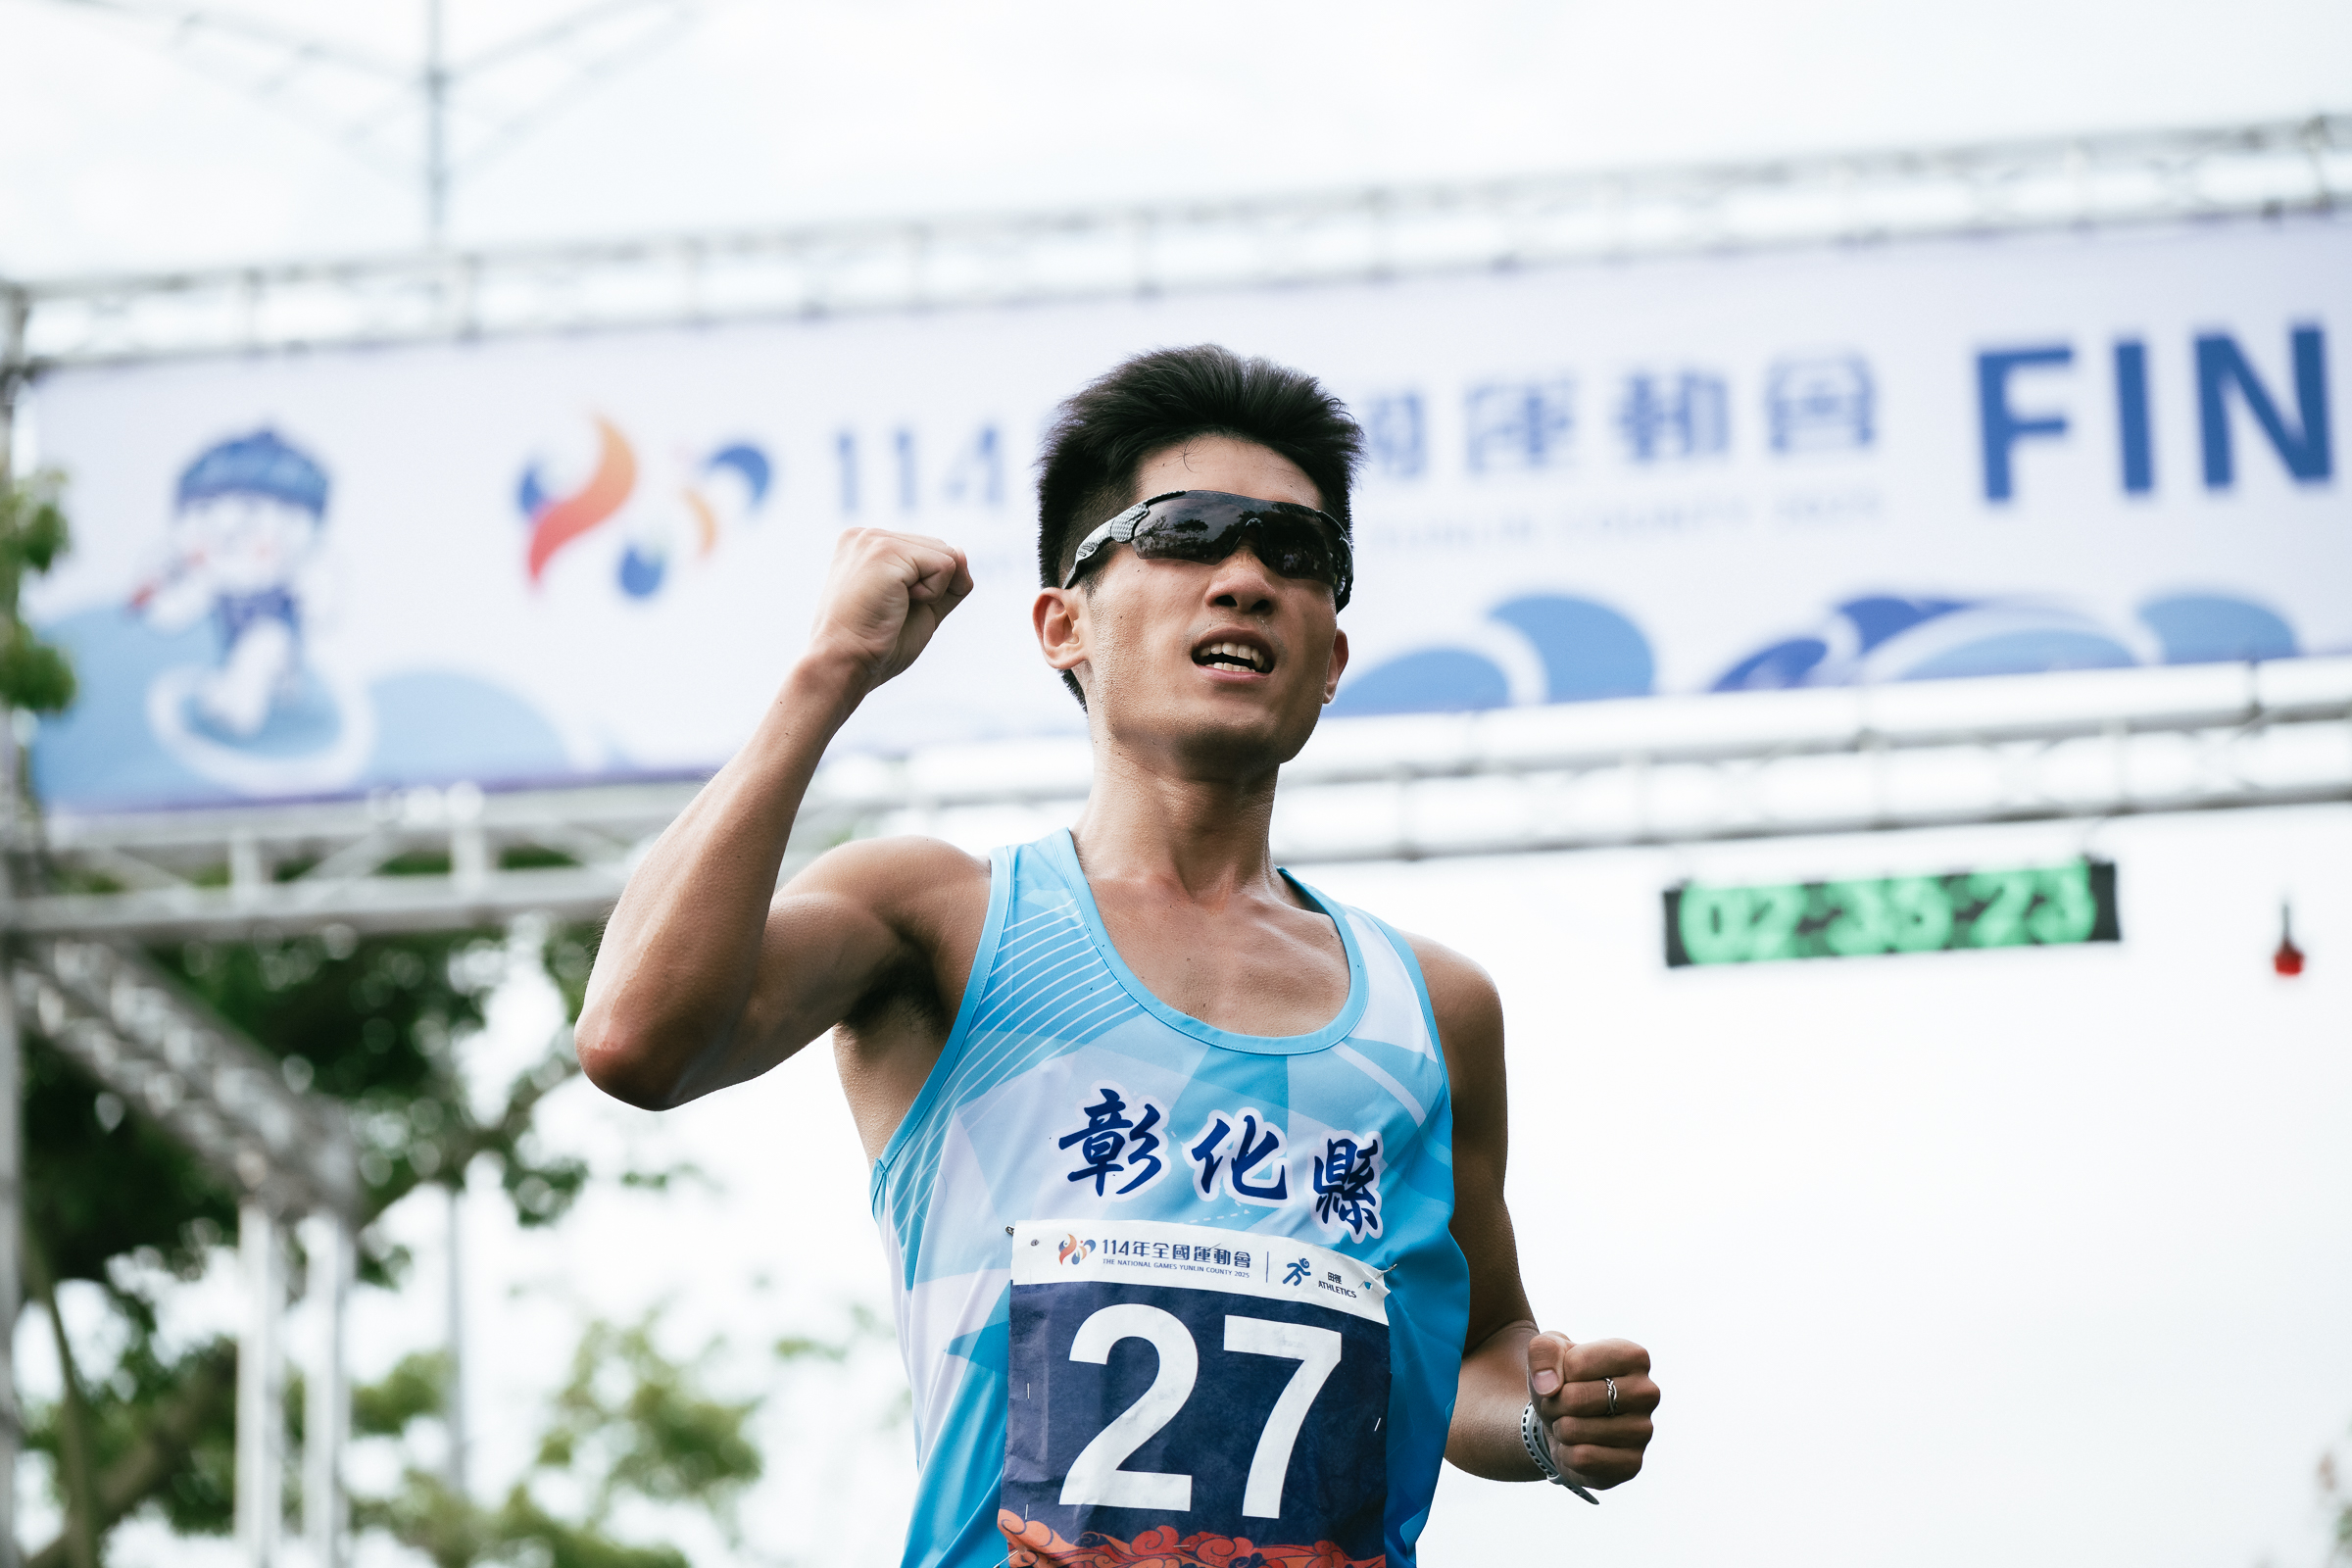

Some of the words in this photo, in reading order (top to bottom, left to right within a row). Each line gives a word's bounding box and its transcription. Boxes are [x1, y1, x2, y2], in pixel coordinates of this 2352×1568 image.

[1975, 324, 2332, 502] FIN
[832, 421, 1006, 517] 114
[1058, 1088, 1378, 1235] 彰化縣
[1102, 1239, 1250, 1268] 114年全國運動會
[1117, 1259, 1152, 1268] NATIONAL
[1205, 1266, 1232, 1275] COUNTY
[1318, 1280, 1357, 1298] ATHLETICS
[1058, 1303, 1342, 1519] 27
